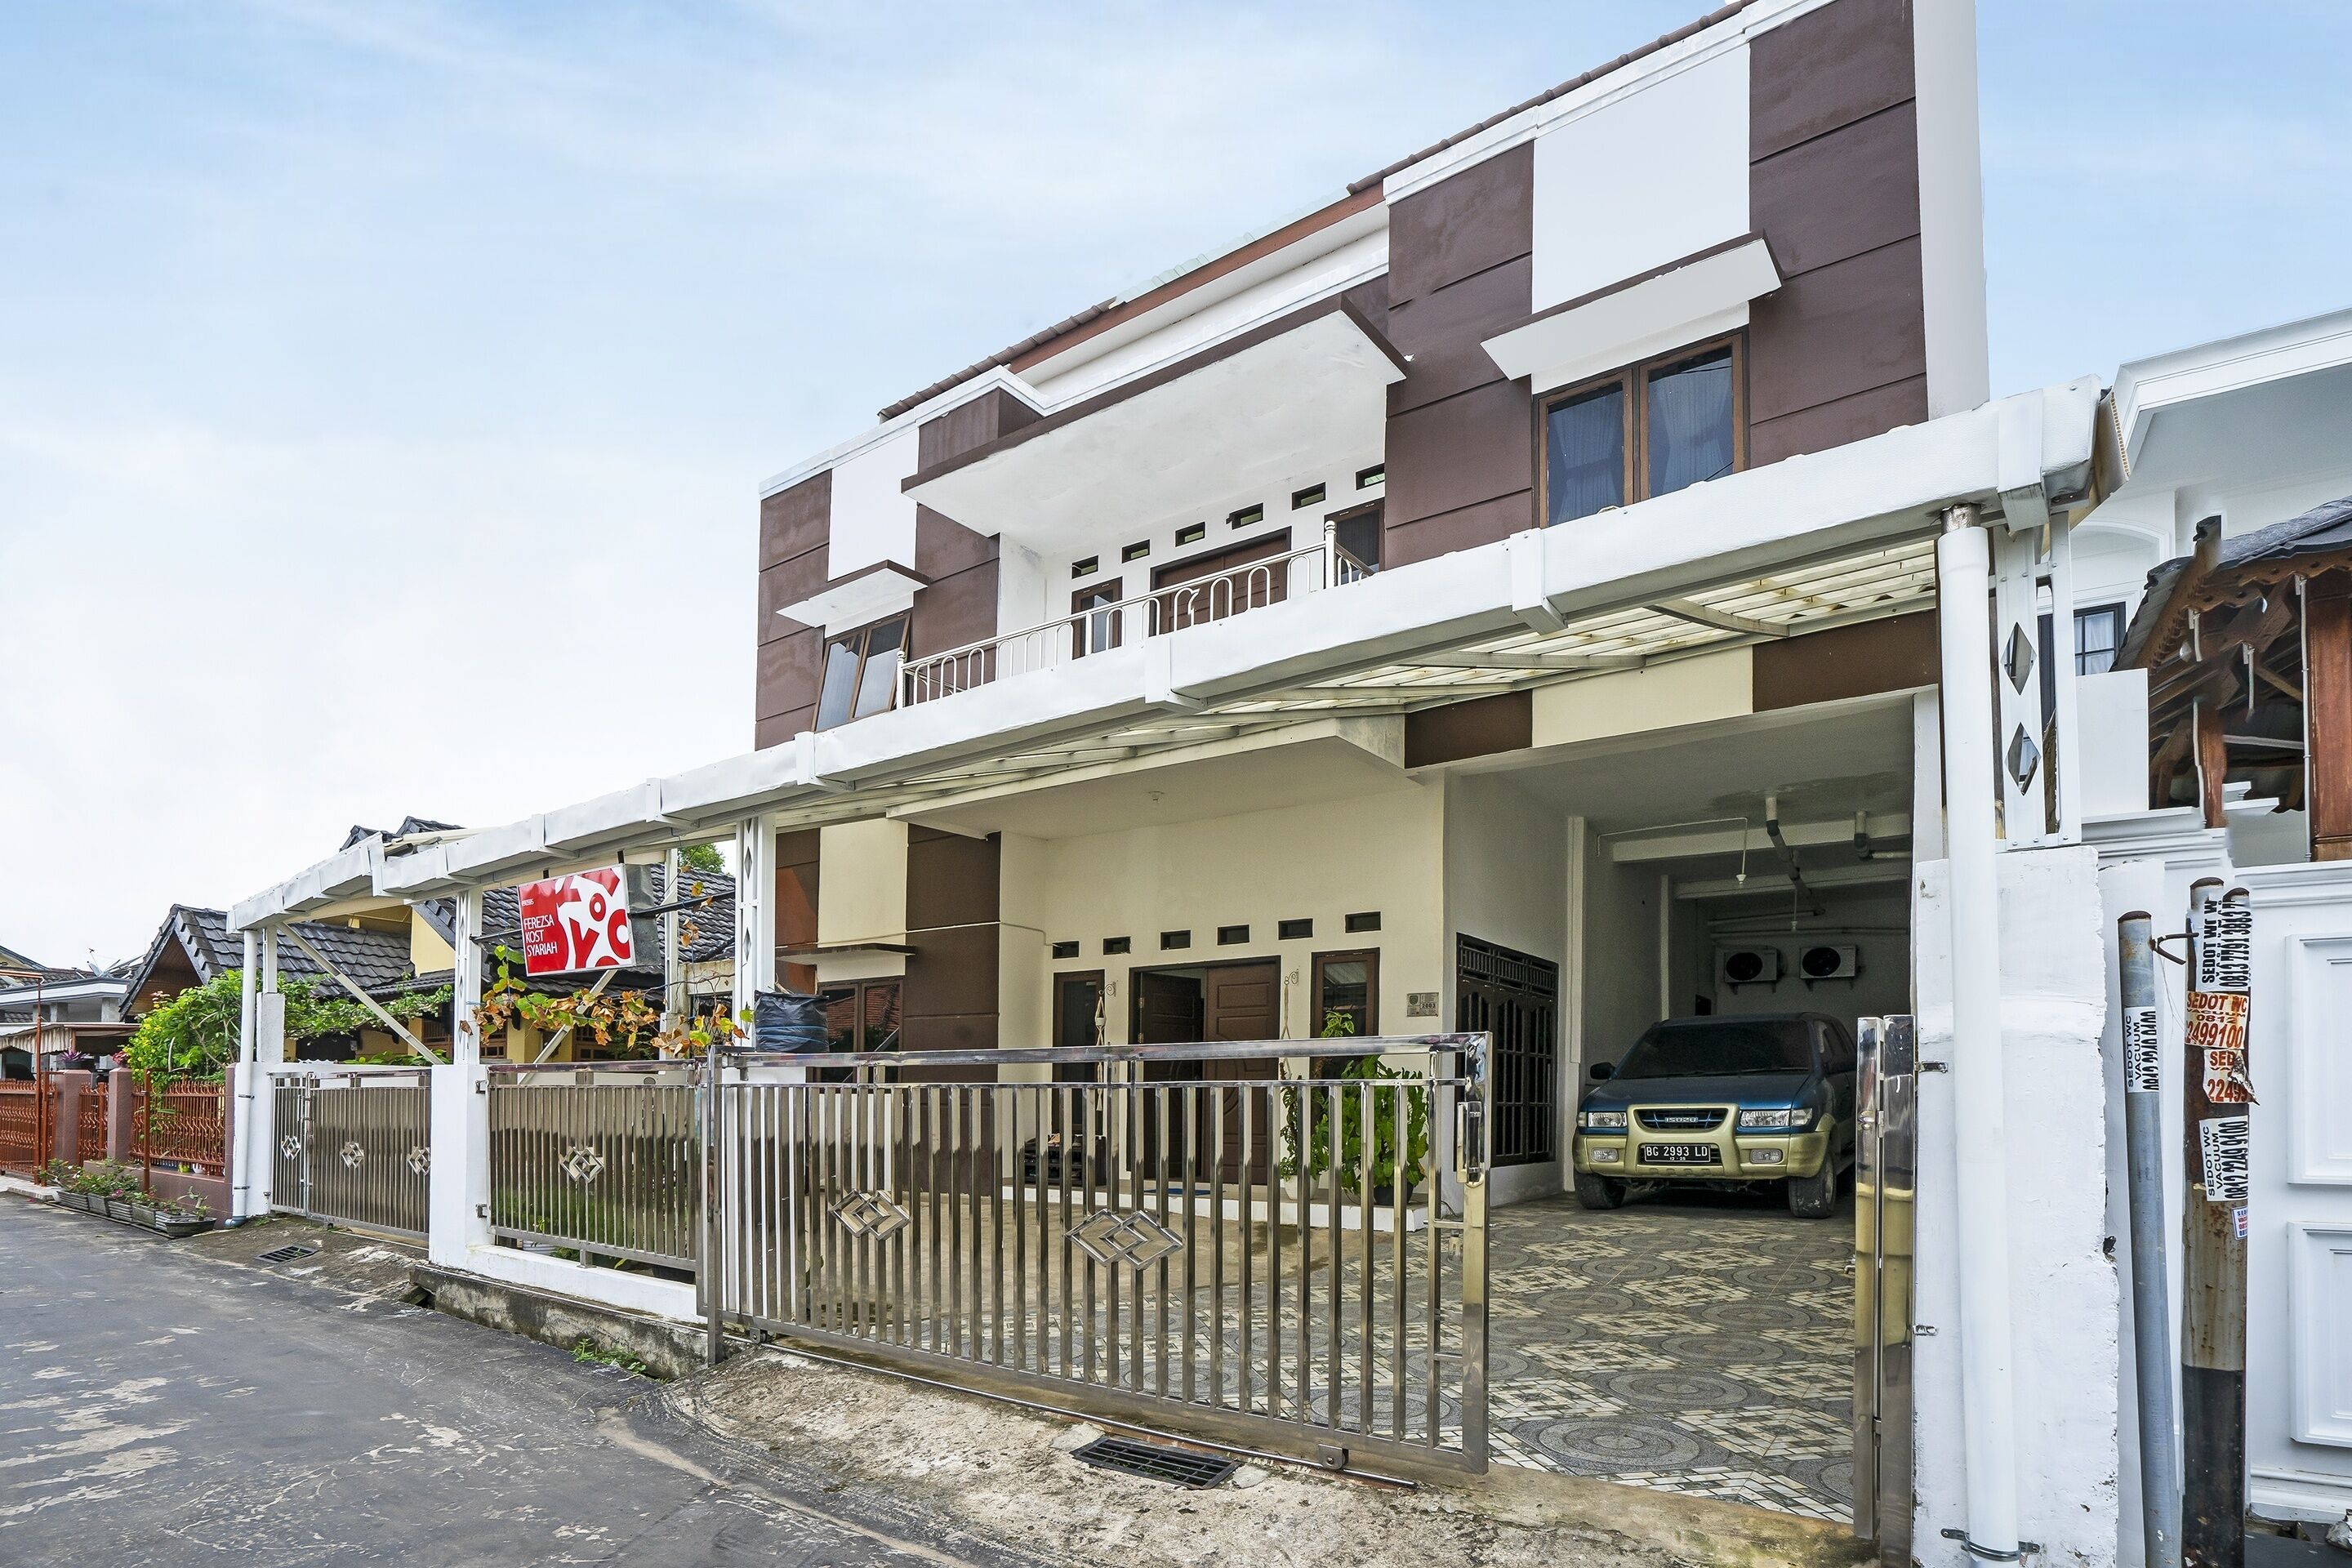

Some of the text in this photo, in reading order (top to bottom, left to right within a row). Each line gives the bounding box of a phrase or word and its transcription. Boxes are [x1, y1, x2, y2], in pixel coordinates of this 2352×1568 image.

[523, 915, 555, 930] FEREZSA
[525, 929, 545, 944] KOST
[528, 942, 558, 957] SYARIAH
[2202, 942, 2216, 983] SEDOT
[2186, 992, 2229, 1010] SEDOT
[2126, 1015, 2132, 1038] WC
[2196, 1013, 2238, 1024] 0812
[2133, 1022, 2141, 1080] VACUUM
[1646, 1146, 1708, 1156] BG 2993 LD
[2203, 1126, 2216, 1196] SEDOT WC
[2212, 1133, 2223, 1190] VACUUM
